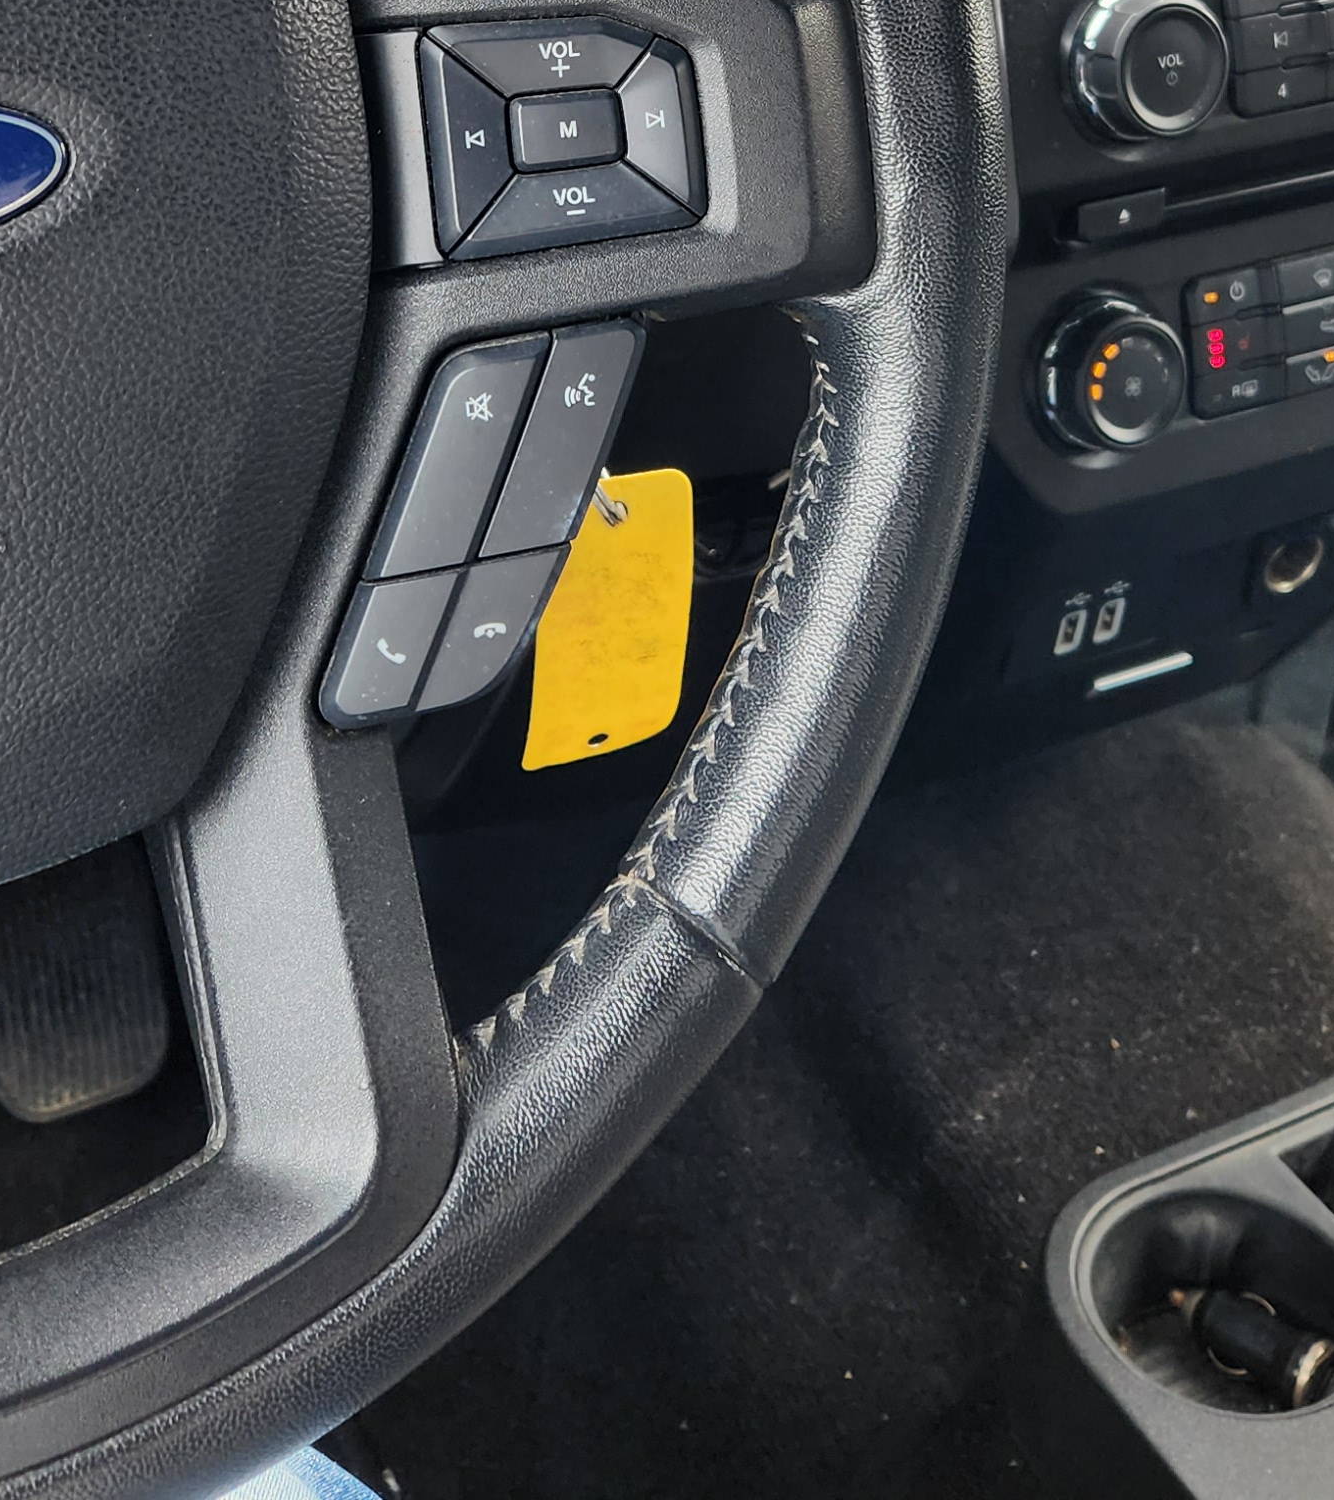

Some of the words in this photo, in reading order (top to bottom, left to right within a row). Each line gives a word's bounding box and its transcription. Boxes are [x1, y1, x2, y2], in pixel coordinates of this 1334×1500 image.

[538, 40, 581, 60] VOL
[1157, 53, 1184, 70] VOL
[1277, 82, 1287, 99] 4
[559, 120, 578, 139] M
[553, 186, 596, 206] VOL
